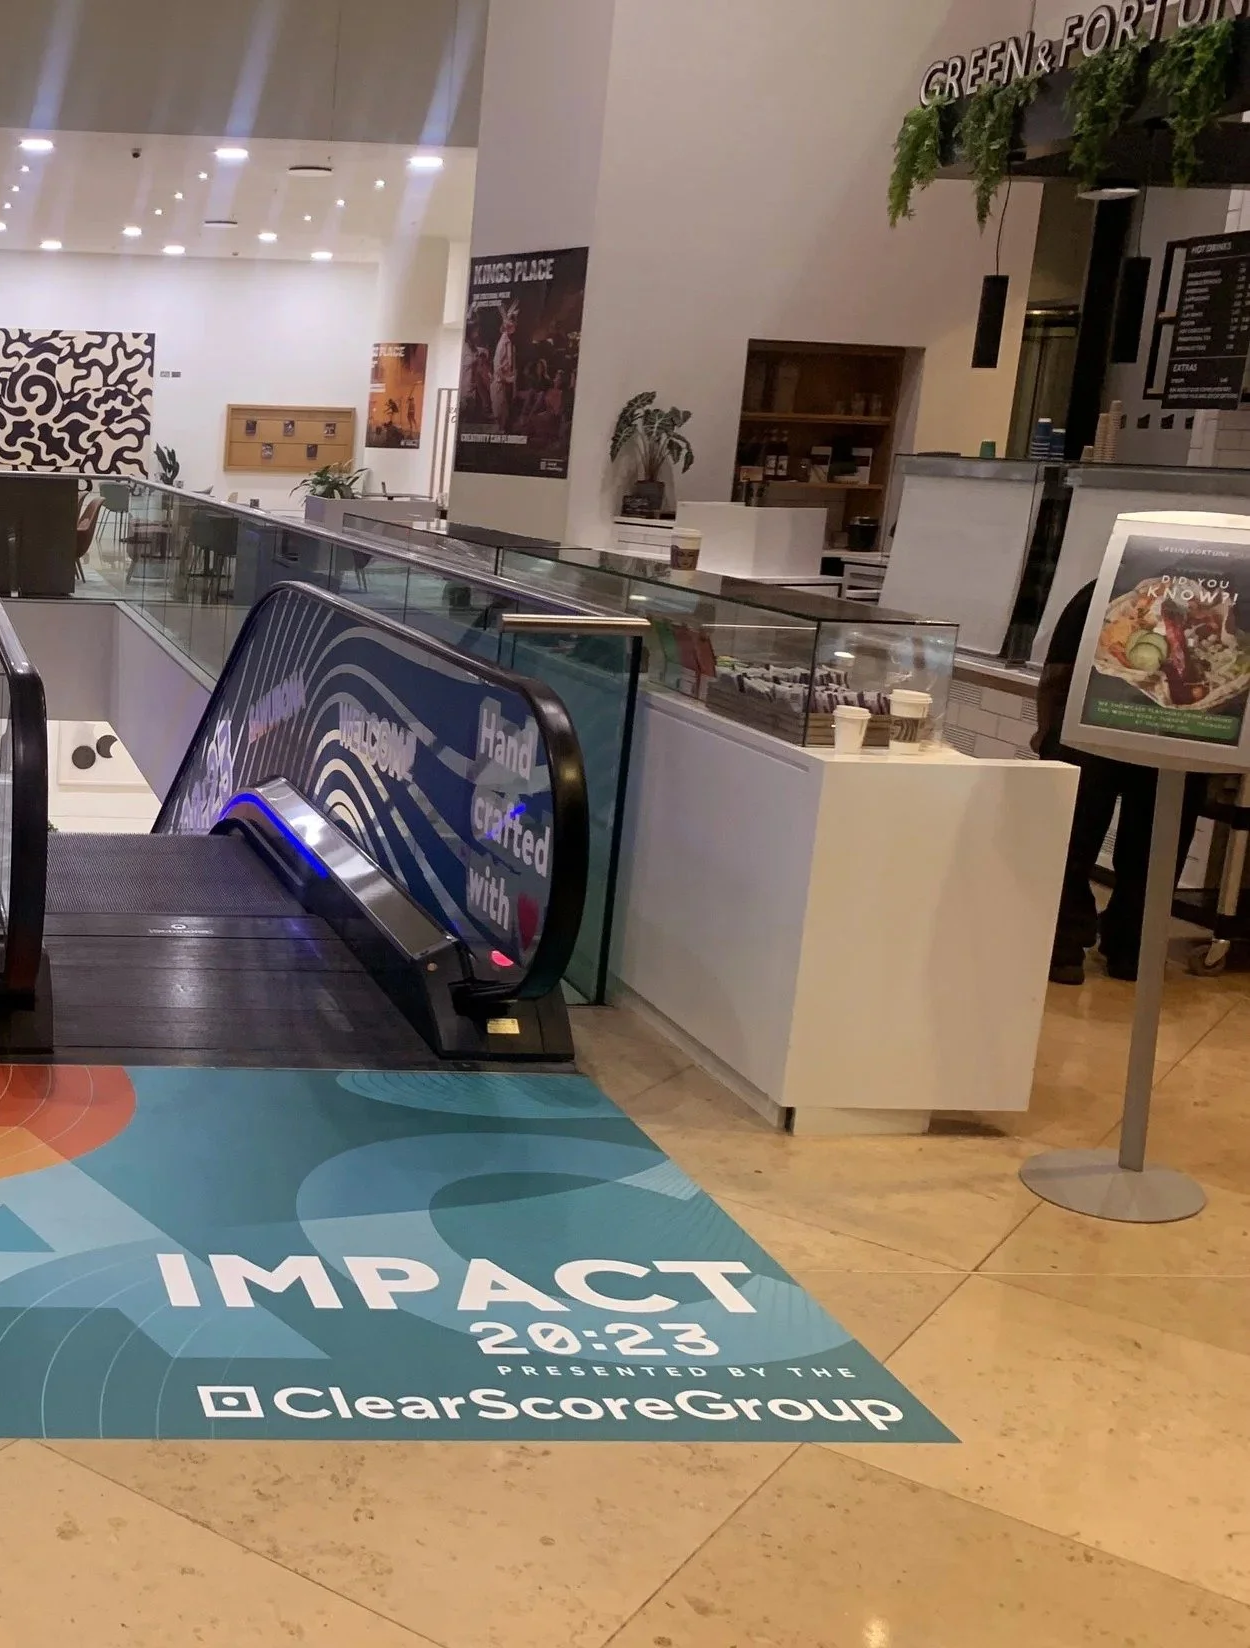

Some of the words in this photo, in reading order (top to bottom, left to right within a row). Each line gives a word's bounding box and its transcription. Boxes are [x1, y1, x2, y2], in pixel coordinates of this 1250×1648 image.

[473, 263, 513, 285] KINGS
[514, 258, 554, 282] PLACE
[1172, 363, 1198, 373] EXTRAS
[1146, 586, 1239, 606] KNOW?!
[1160, 574, 1188, 585] DID
[1197, 577, 1231, 589] YOU
[480, 708, 536, 781] Hand
[473, 796, 550, 878] crafted
[469, 866, 510, 931] with
[155, 1253, 759, 1314] IMPACT
[470, 1321, 721, 1357] 20:23
[496, 1365, 707, 1377] PRESENTED
[727, 1367, 766, 1377] BY
[786, 1367, 856, 1378] THE
[273, 1386, 905, 1432] ClearScoreGroup
